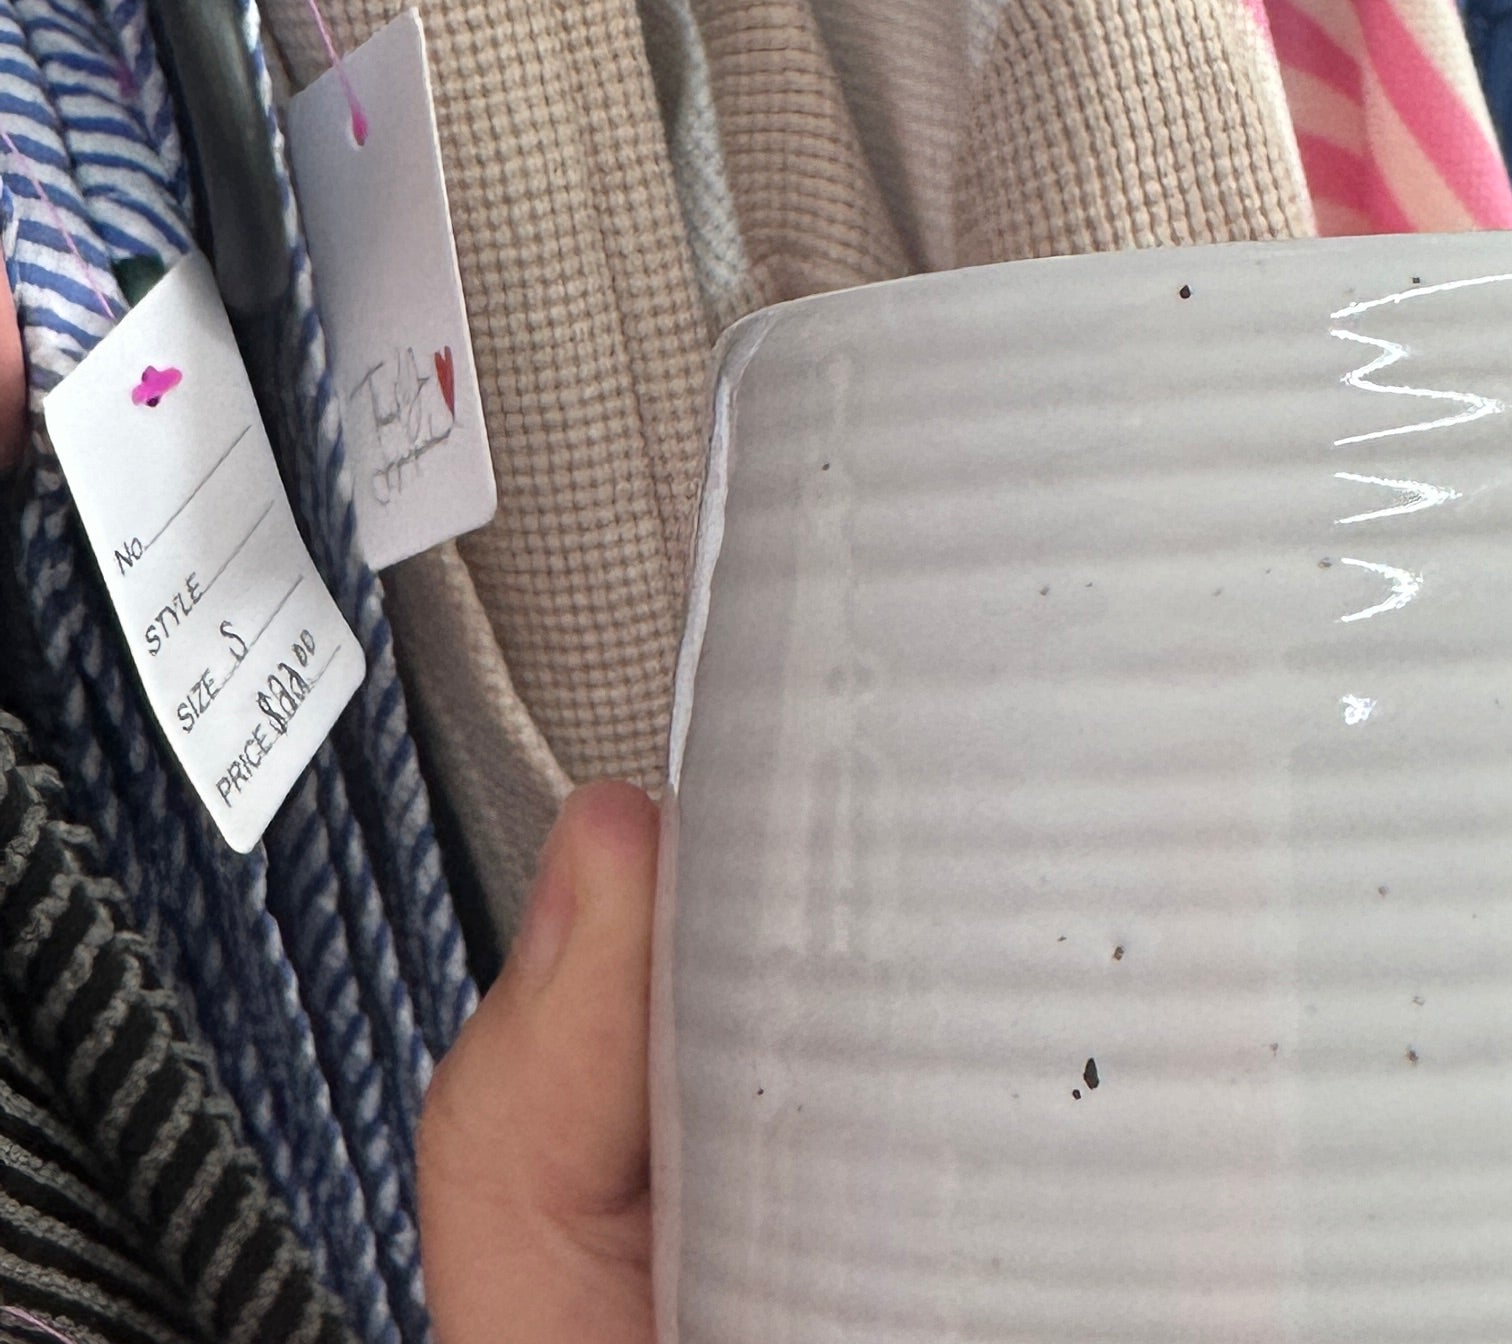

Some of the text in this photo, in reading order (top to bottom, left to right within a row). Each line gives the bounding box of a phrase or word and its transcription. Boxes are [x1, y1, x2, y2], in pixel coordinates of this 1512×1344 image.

[144, 571, 202, 656] STYLE
[176, 620, 249, 733] SIZE S
[215, 722, 273, 808] PRICE
